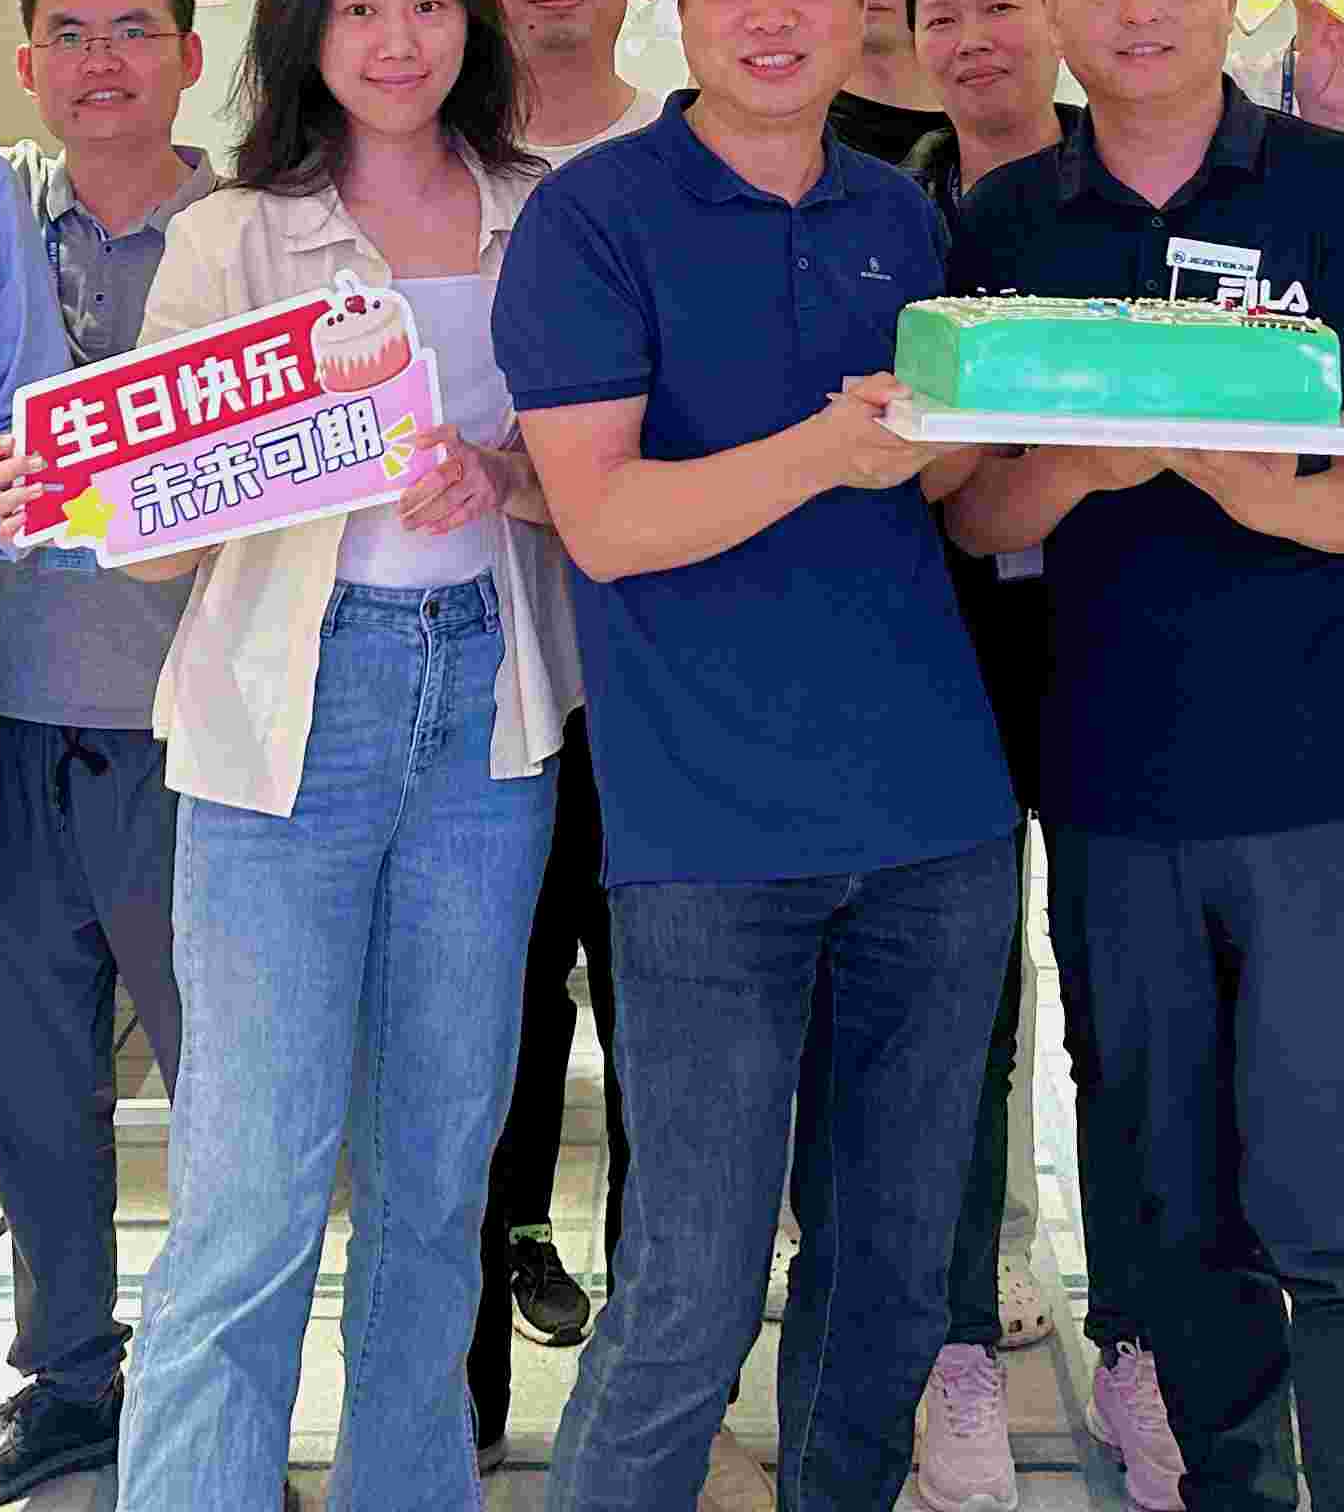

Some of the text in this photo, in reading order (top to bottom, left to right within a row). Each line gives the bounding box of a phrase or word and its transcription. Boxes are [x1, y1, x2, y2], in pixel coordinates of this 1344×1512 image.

[50, 334, 304, 469] 生日快乐
[131, 396, 384, 535] 未来可期
